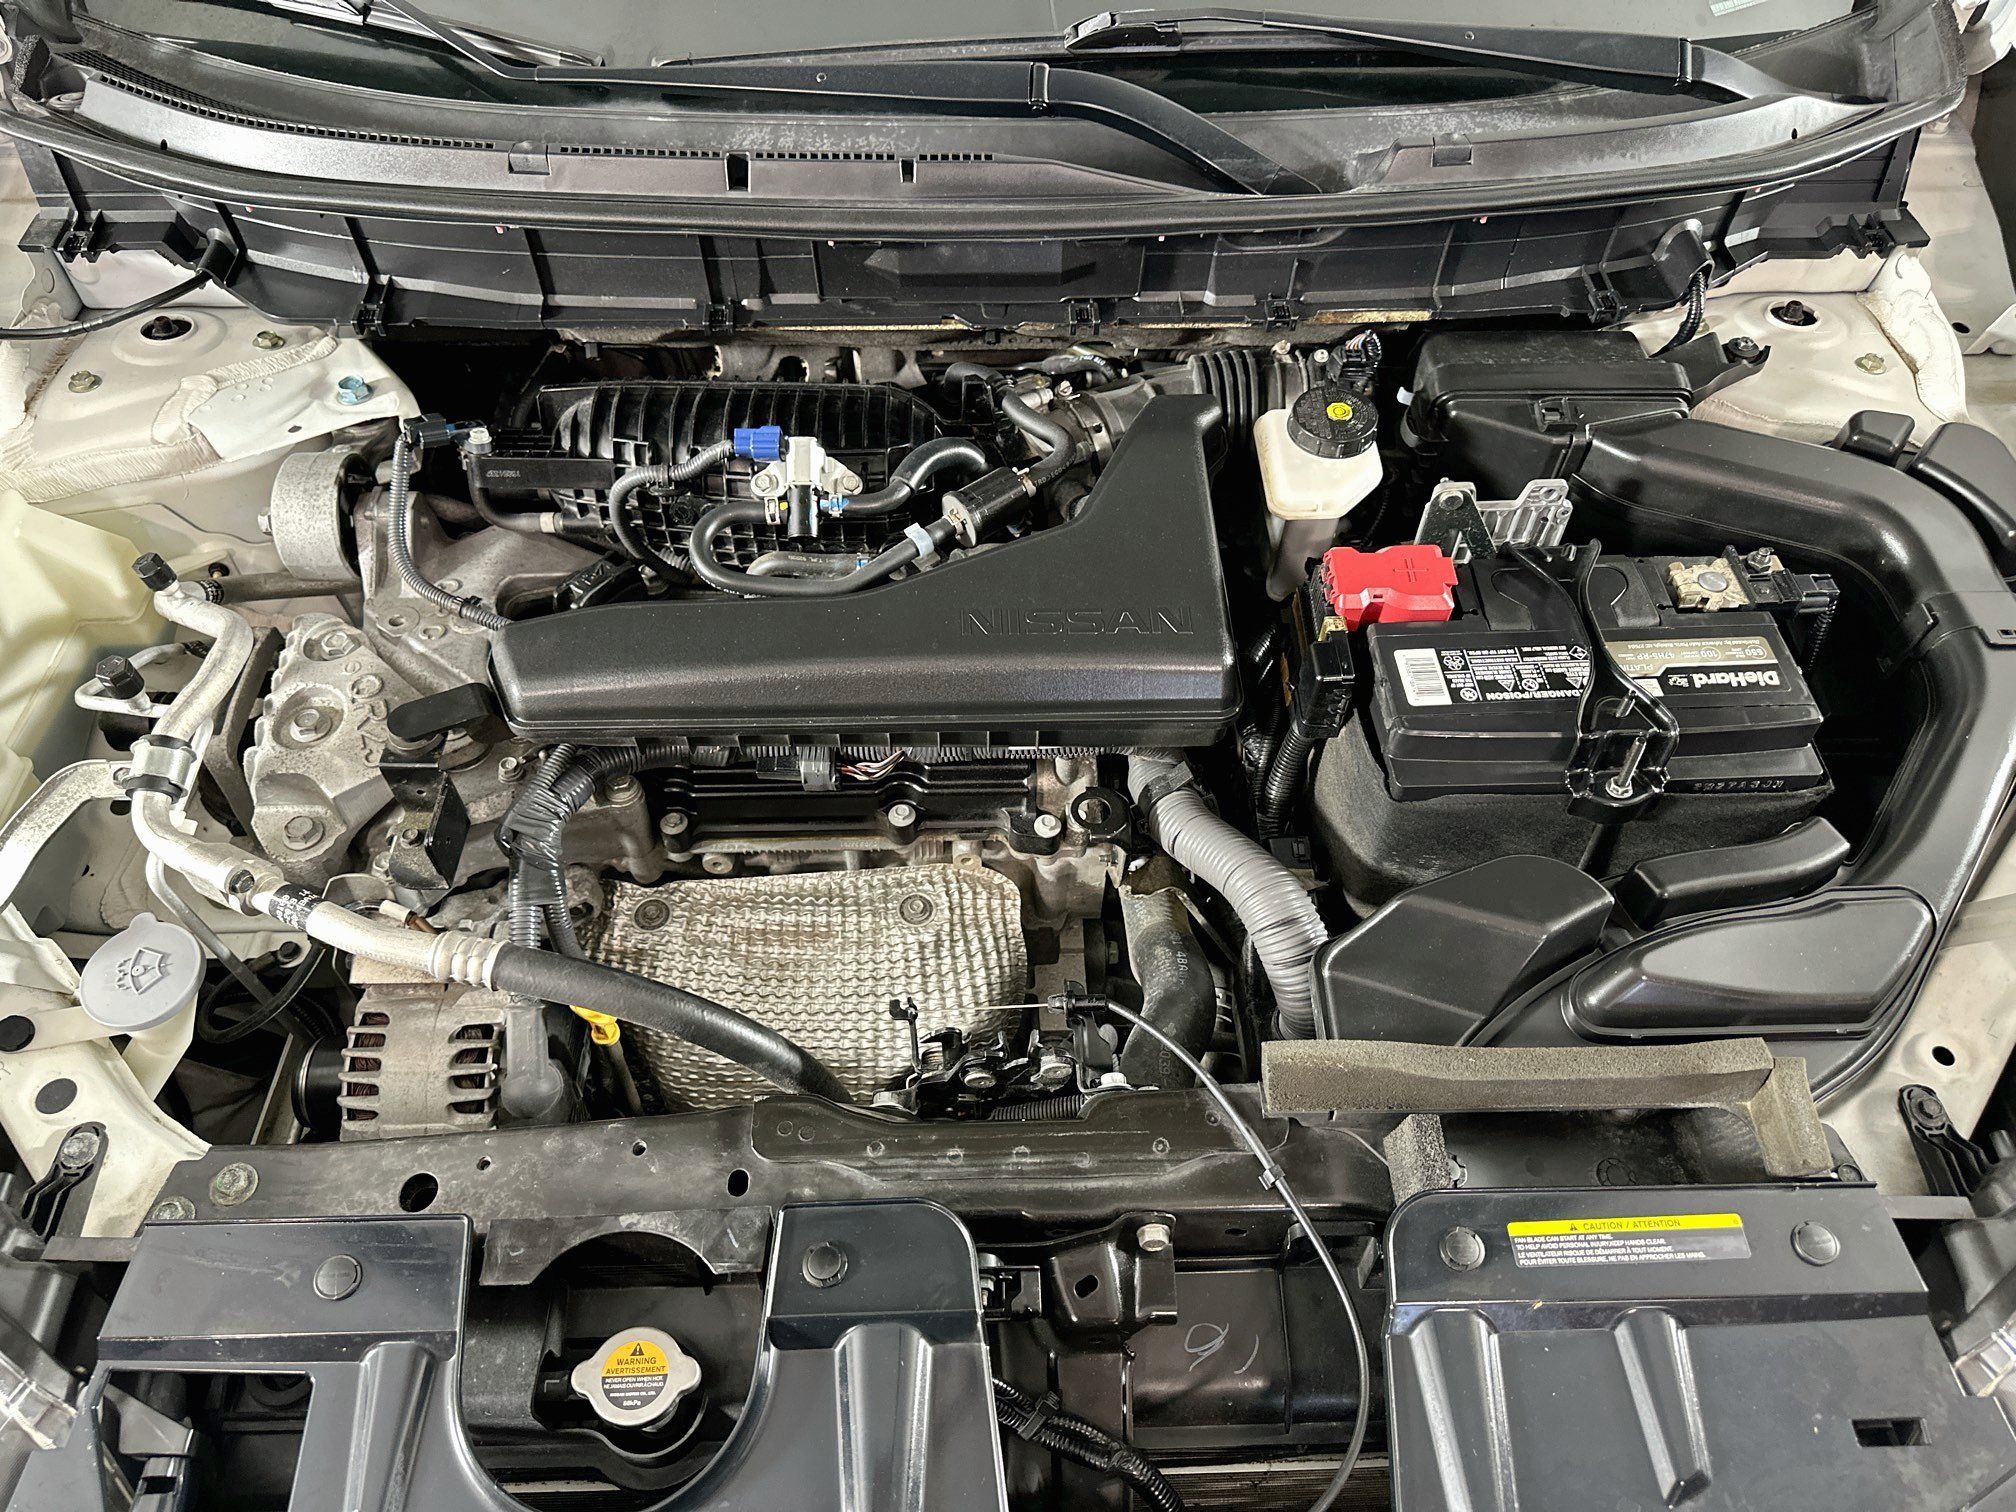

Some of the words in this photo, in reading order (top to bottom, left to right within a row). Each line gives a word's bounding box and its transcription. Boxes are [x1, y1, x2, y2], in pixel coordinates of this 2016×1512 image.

[960, 607, 1195, 636] NISSAN
[1701, 650, 1717, 658] 100
[1692, 671, 1780, 689] DieHard
[1486, 689, 1581, 700] DANGER/POISON
[1583, 1221, 1623, 1231] CAUTION
[1633, 1219, 1681, 1229] ATTENTION
[1559, 1241, 1590, 1249] PERSONAL
[1526, 1250, 1562, 1258] VENTILATEUR
[1563, 1249, 1585, 1257] RISQUE
[1538, 1257, 1557, 1265] ÉVITER
[616, 1356, 657, 1365] WARNING
[606, 1366, 666, 1374] AVERTISSEMENT
